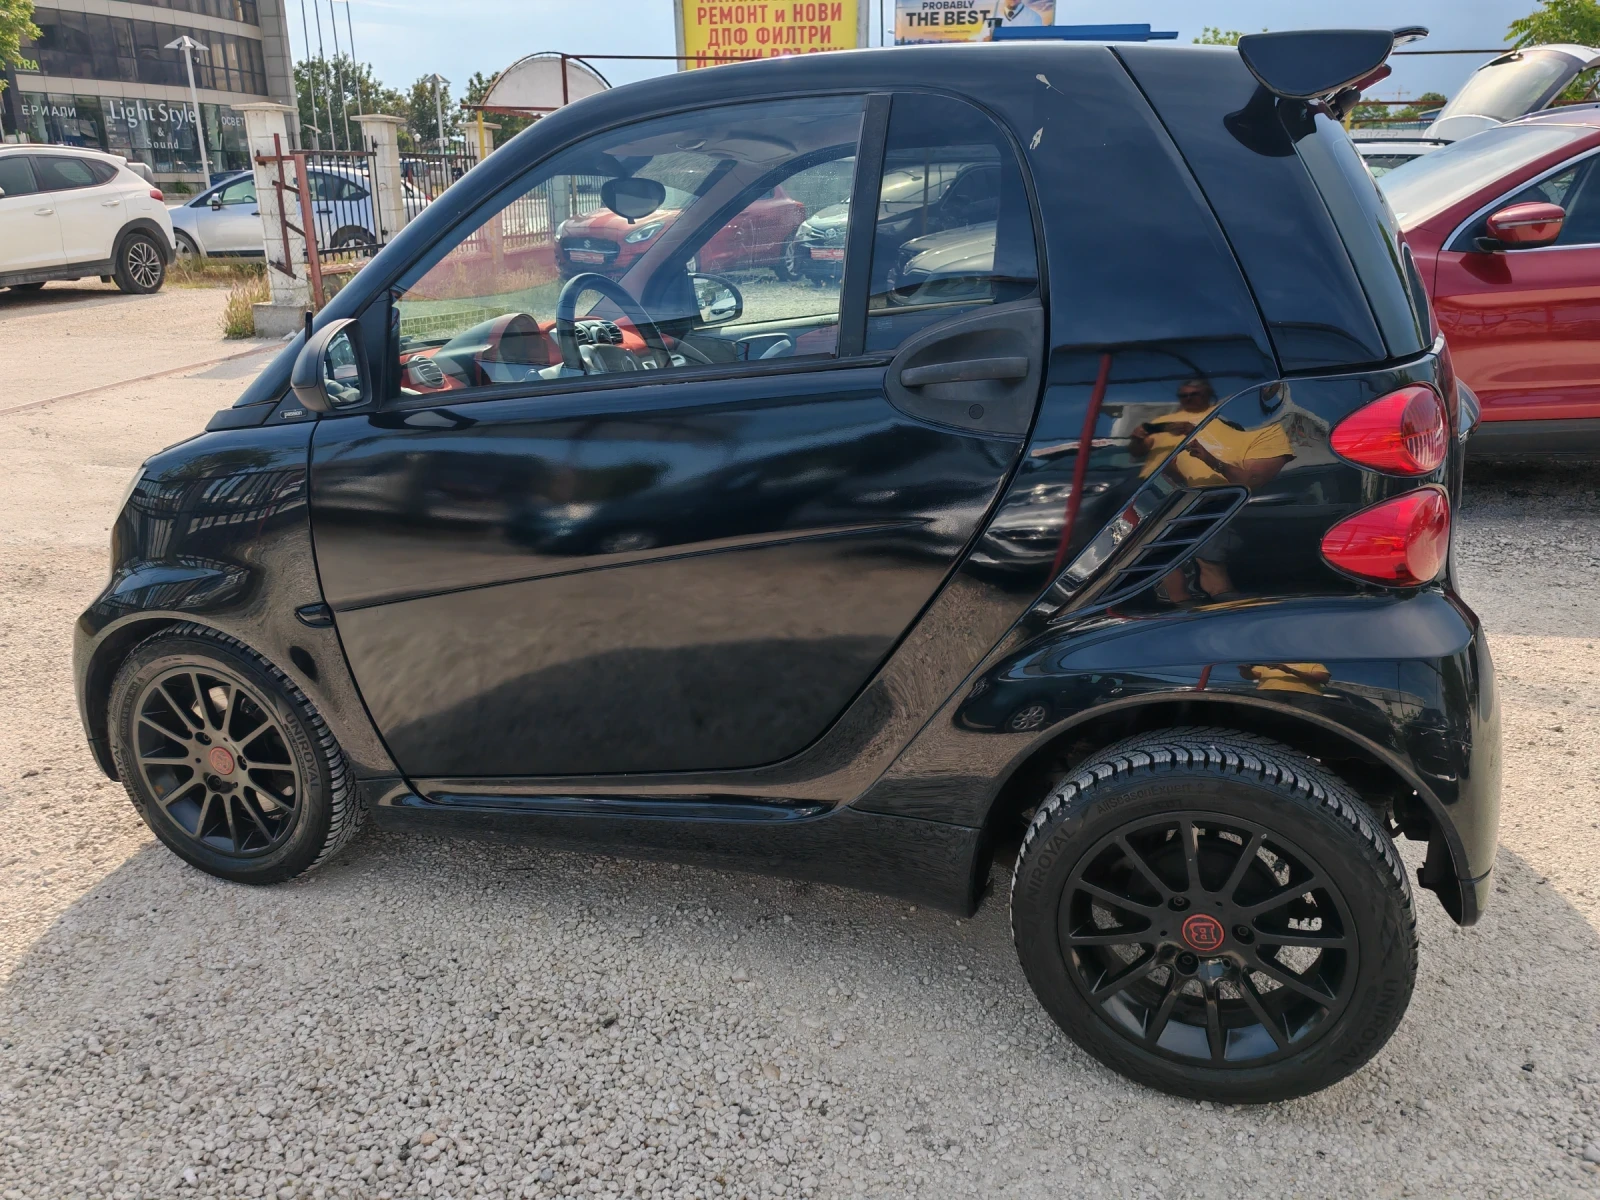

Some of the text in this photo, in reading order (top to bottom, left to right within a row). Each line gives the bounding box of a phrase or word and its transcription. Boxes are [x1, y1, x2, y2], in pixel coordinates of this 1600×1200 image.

[697, 3, 842, 25] РЕМОНТ и НОВИ
[922, 1, 974, 10] PROBABLY
[906, 10, 990, 26] THE BEST
[708, 25, 831, 50] ДПФ ФИЛТРИ
[109, 100, 197, 129] Light Style
[157, 127, 165, 137] &
[146, 139, 179, 149] Sound
[285, 712, 319, 790] UNIROYAL
[1096, 782, 1191, 814] AllSeasonExpert
[1331, 979, 1399, 1065] UNIROYAL
